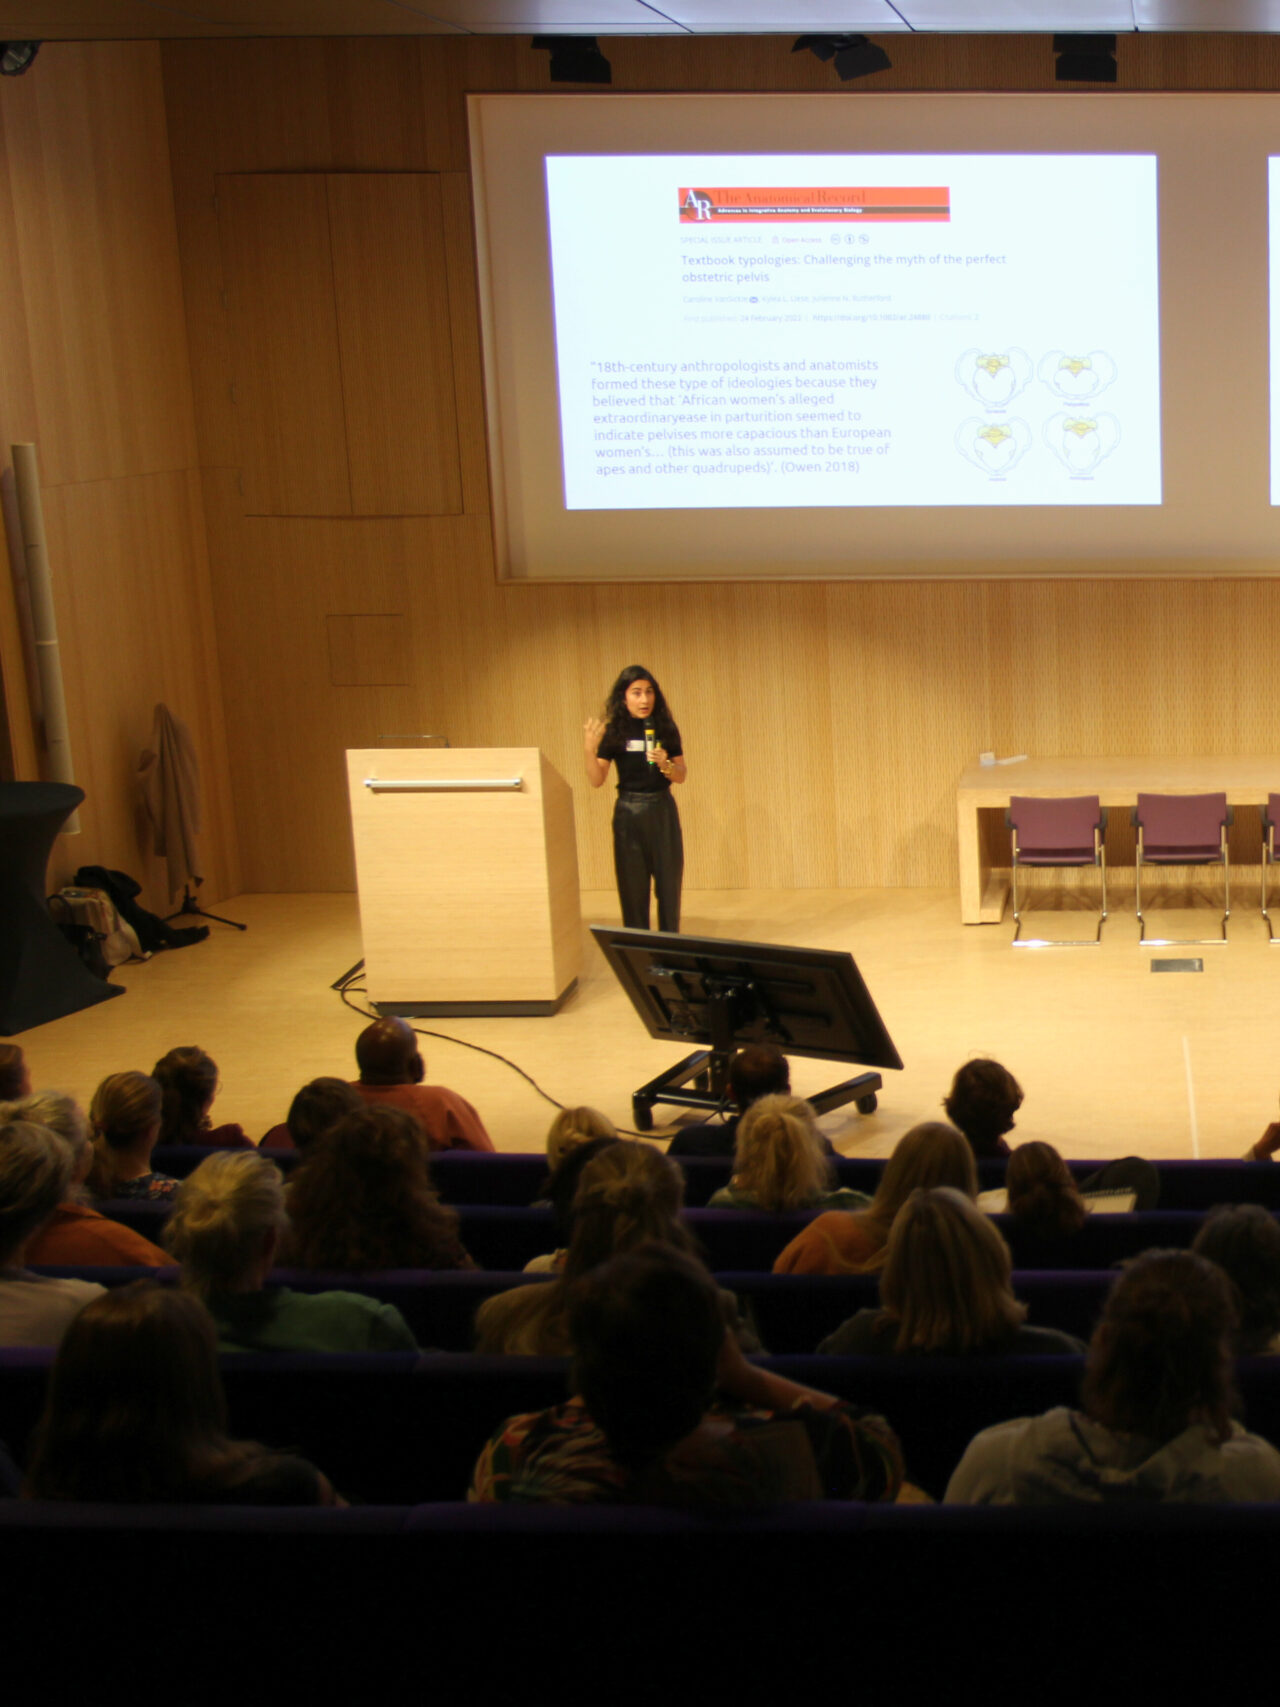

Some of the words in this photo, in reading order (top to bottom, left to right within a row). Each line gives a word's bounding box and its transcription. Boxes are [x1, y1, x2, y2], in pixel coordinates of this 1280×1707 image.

[680, 255, 736, 264] Textbook
[738, 255, 801, 267] typologies:
[803, 254, 871, 267] Challenging
[873, 254, 893, 263] the
[895, 254, 926, 266] myth
[928, 253, 941, 263] of
[943, 254, 962, 263] the
[965, 254, 1007, 265] perfect
[682, 272, 733, 281] obstetric
[736, 272, 770, 283] pelvis
[680, 360, 780, 373] anthropologists
[783, 359, 806, 370] and
[810, 360, 878, 370] anatomists
[591, 378, 638, 389] formed
[640, 377, 677, 388] these
[679, 378, 708, 390] type
[710, 376, 725, 387] of
[727, 376, 793, 390] ideologies
[795, 376, 846, 387] because
[849, 376, 878, 388] they
[592, 395, 646, 406] believed
[648, 394, 677, 405] that
[788, 393, 835, 406] alleged
[593, 413, 708, 424] extraordinaryease
[710, 411, 722, 421] in
[724, 410, 793, 423] parturition
[795, 410, 845, 420] seemed
[847, 410, 862, 420] to
[594, 429, 645, 440] indicate
[647, 429, 698, 441] pelvises
[700, 430, 734, 439] more
[736, 428, 798, 441] capacious
[800, 427, 829, 438] than
[831, 427, 892, 439] European
[668, 445, 695, 457] (this
[725, 444, 750, 455] also
[754, 444, 807, 455] assumed
[811, 445, 824, 454] to
[828, 443, 843, 454] be
[847, 444, 872, 454] true
[876, 443, 889, 455] of
[596, 466, 626, 476] apes
[627, 462, 652, 473] and
[654, 462, 689, 473] other
[780, 461, 822, 472] (Owen
[825, 461, 861, 473] 2018)
